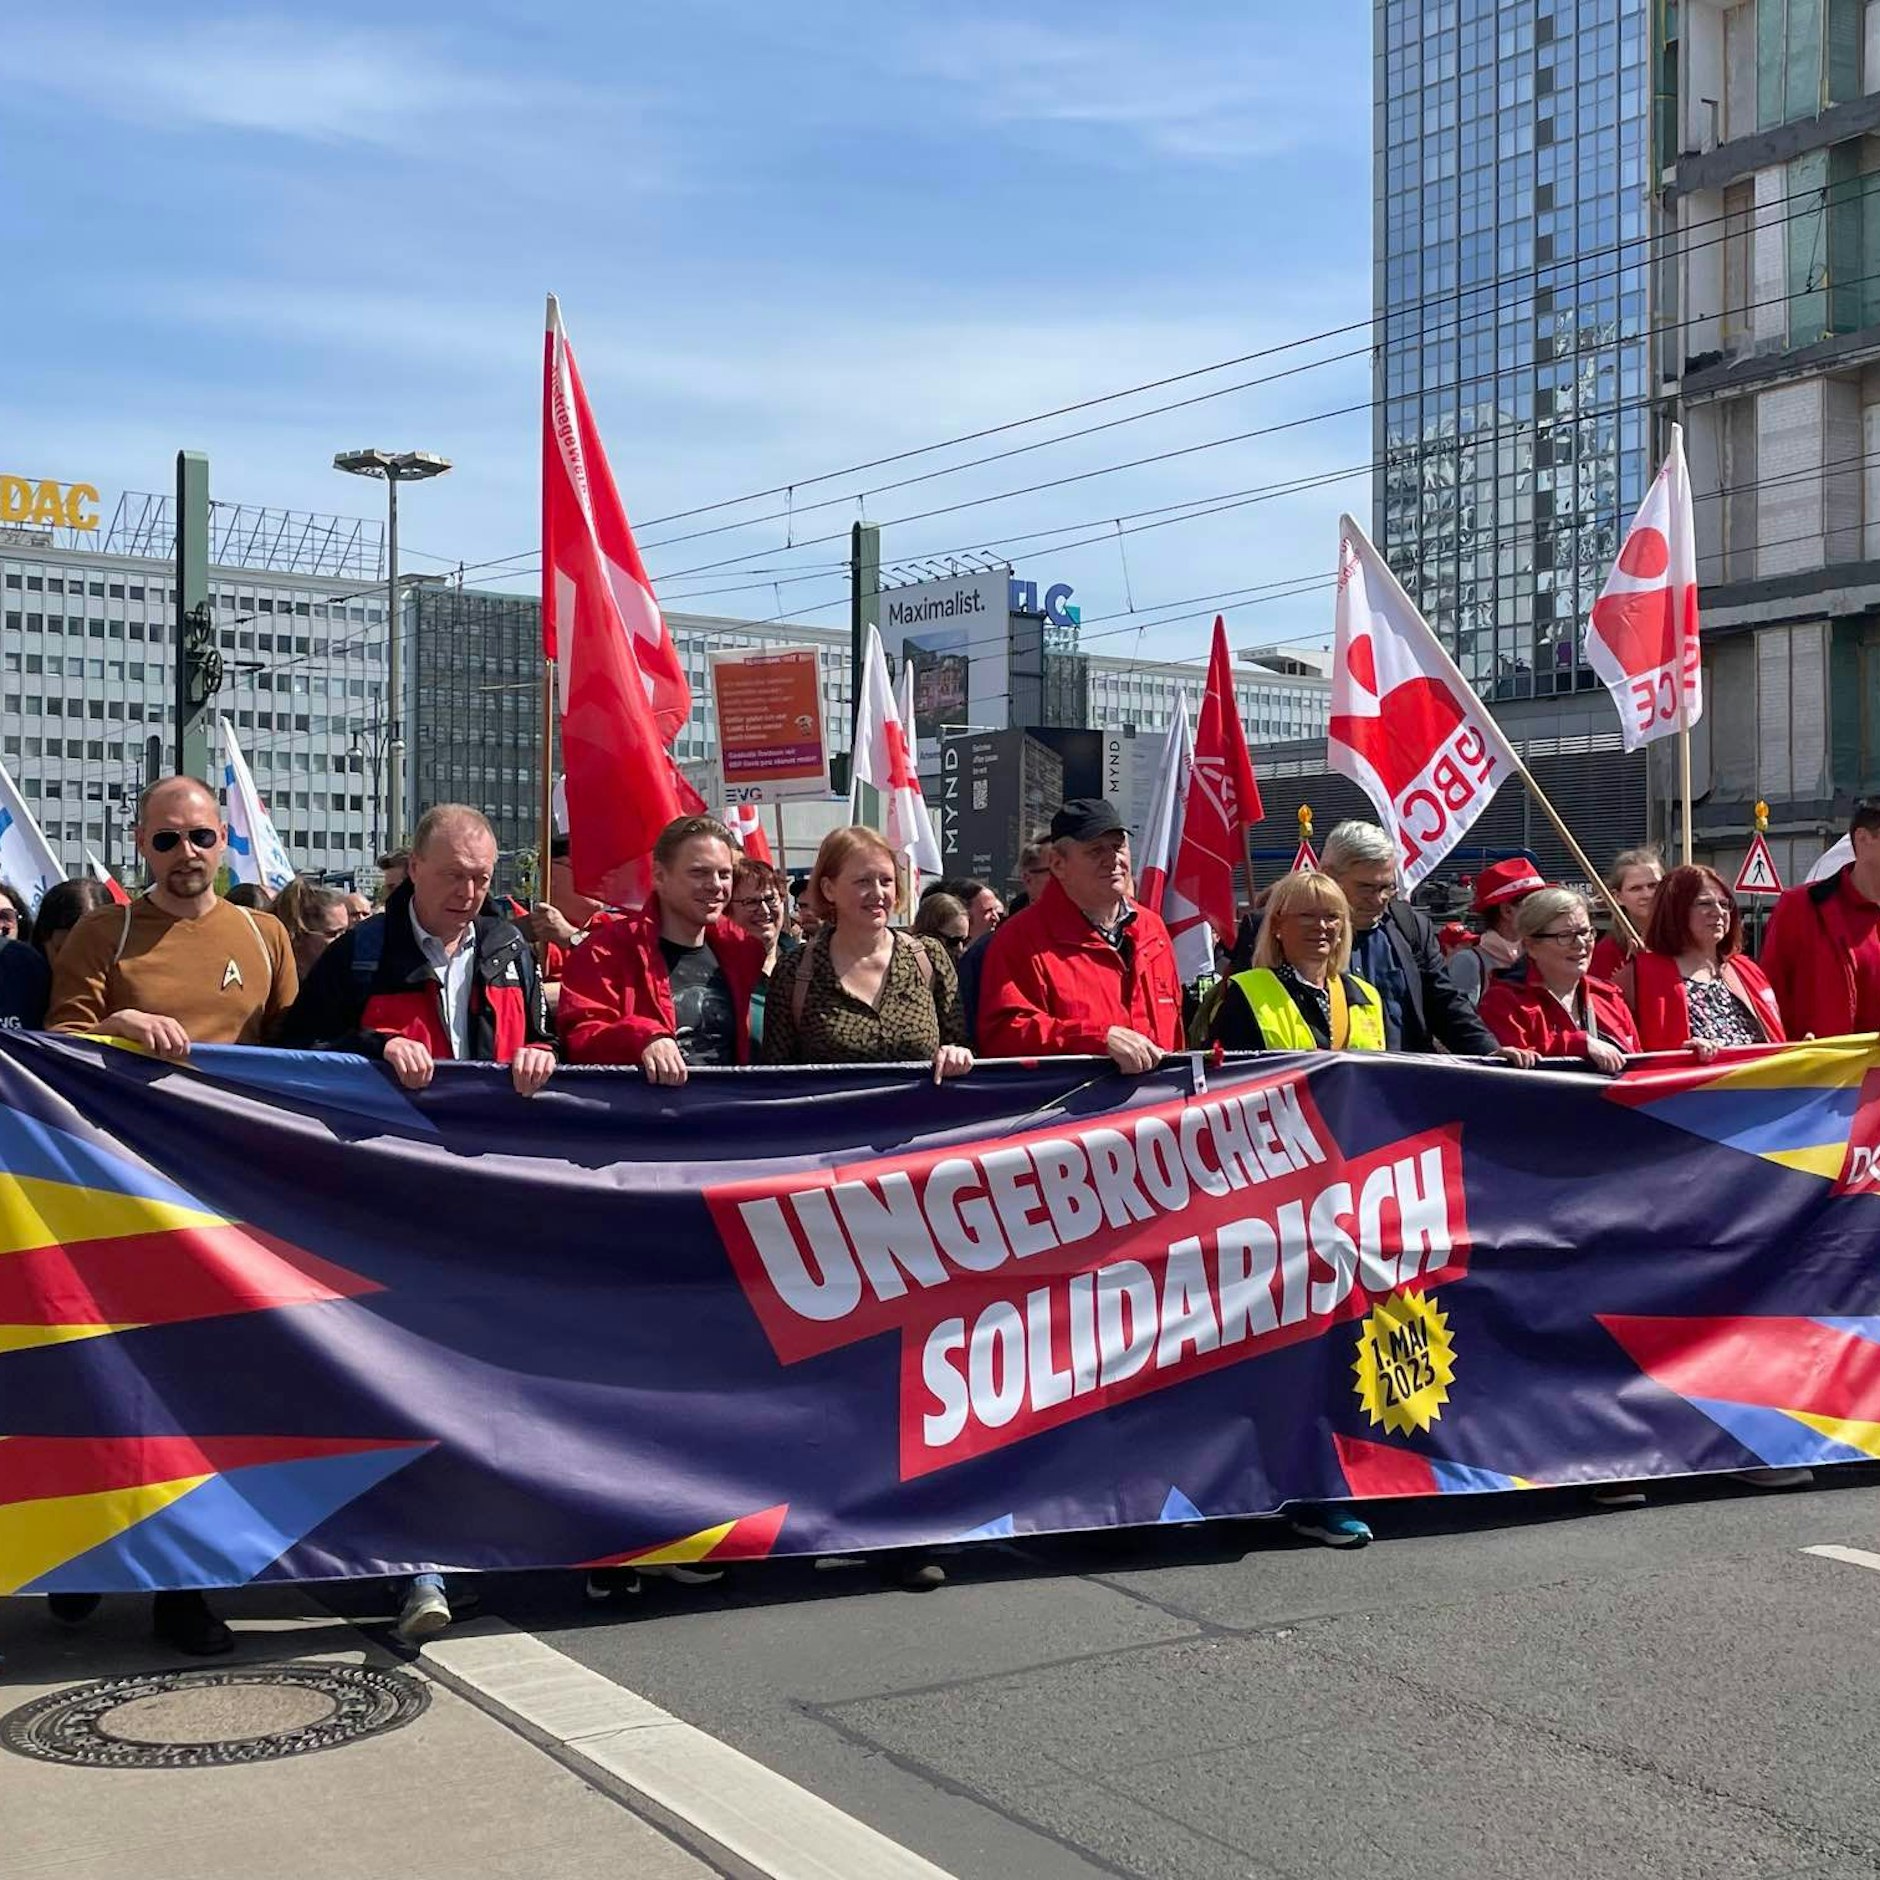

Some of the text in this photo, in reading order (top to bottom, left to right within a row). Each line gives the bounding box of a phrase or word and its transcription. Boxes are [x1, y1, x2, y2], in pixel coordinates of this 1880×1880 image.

[0, 475, 100, 530] DAC
[889, 588, 986, 627] Maximalist.
[1109, 741, 1121, 793] MYND
[725, 788, 763, 803] EVG
[944, 748, 959, 854] MYND
[738, 1082, 1327, 1322] UNGEBROCHEN
[922, 1145, 1453, 1448] SOLIDARISCH
[1380, 1350, 1436, 1408] 2023
